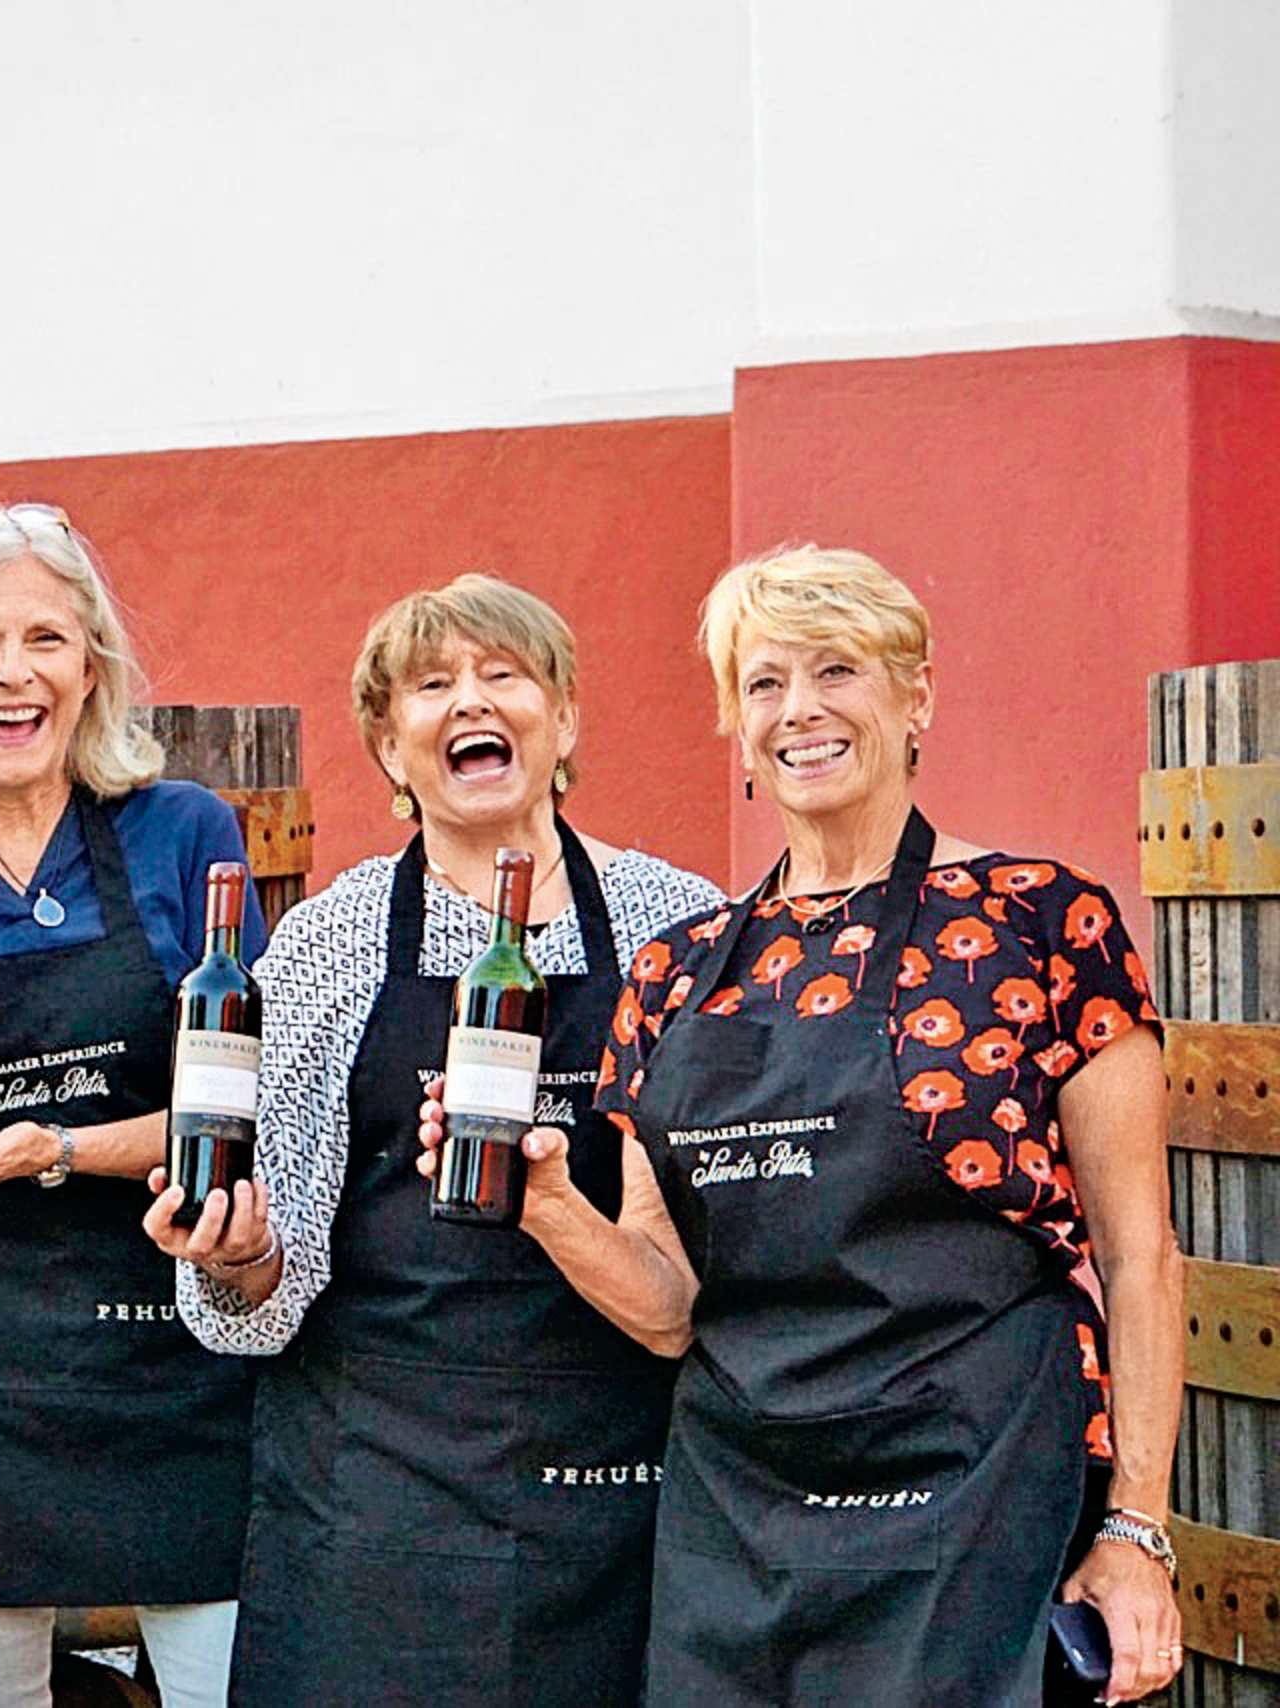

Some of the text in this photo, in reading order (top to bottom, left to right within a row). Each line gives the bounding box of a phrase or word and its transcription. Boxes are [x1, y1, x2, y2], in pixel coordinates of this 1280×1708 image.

[42, 1040, 127, 1068] EXPERIENCE
[55, 1066, 111, 1104] Rita
[539, 1071, 598, 1085] ERIENCE
[667, 1116, 836, 1147] WINEMAKER EXPERIENCE
[691, 1147, 758, 1188] Santa
[760, 1140, 814, 1179] Rita
[96, 1304, 176, 1321] PEHU
